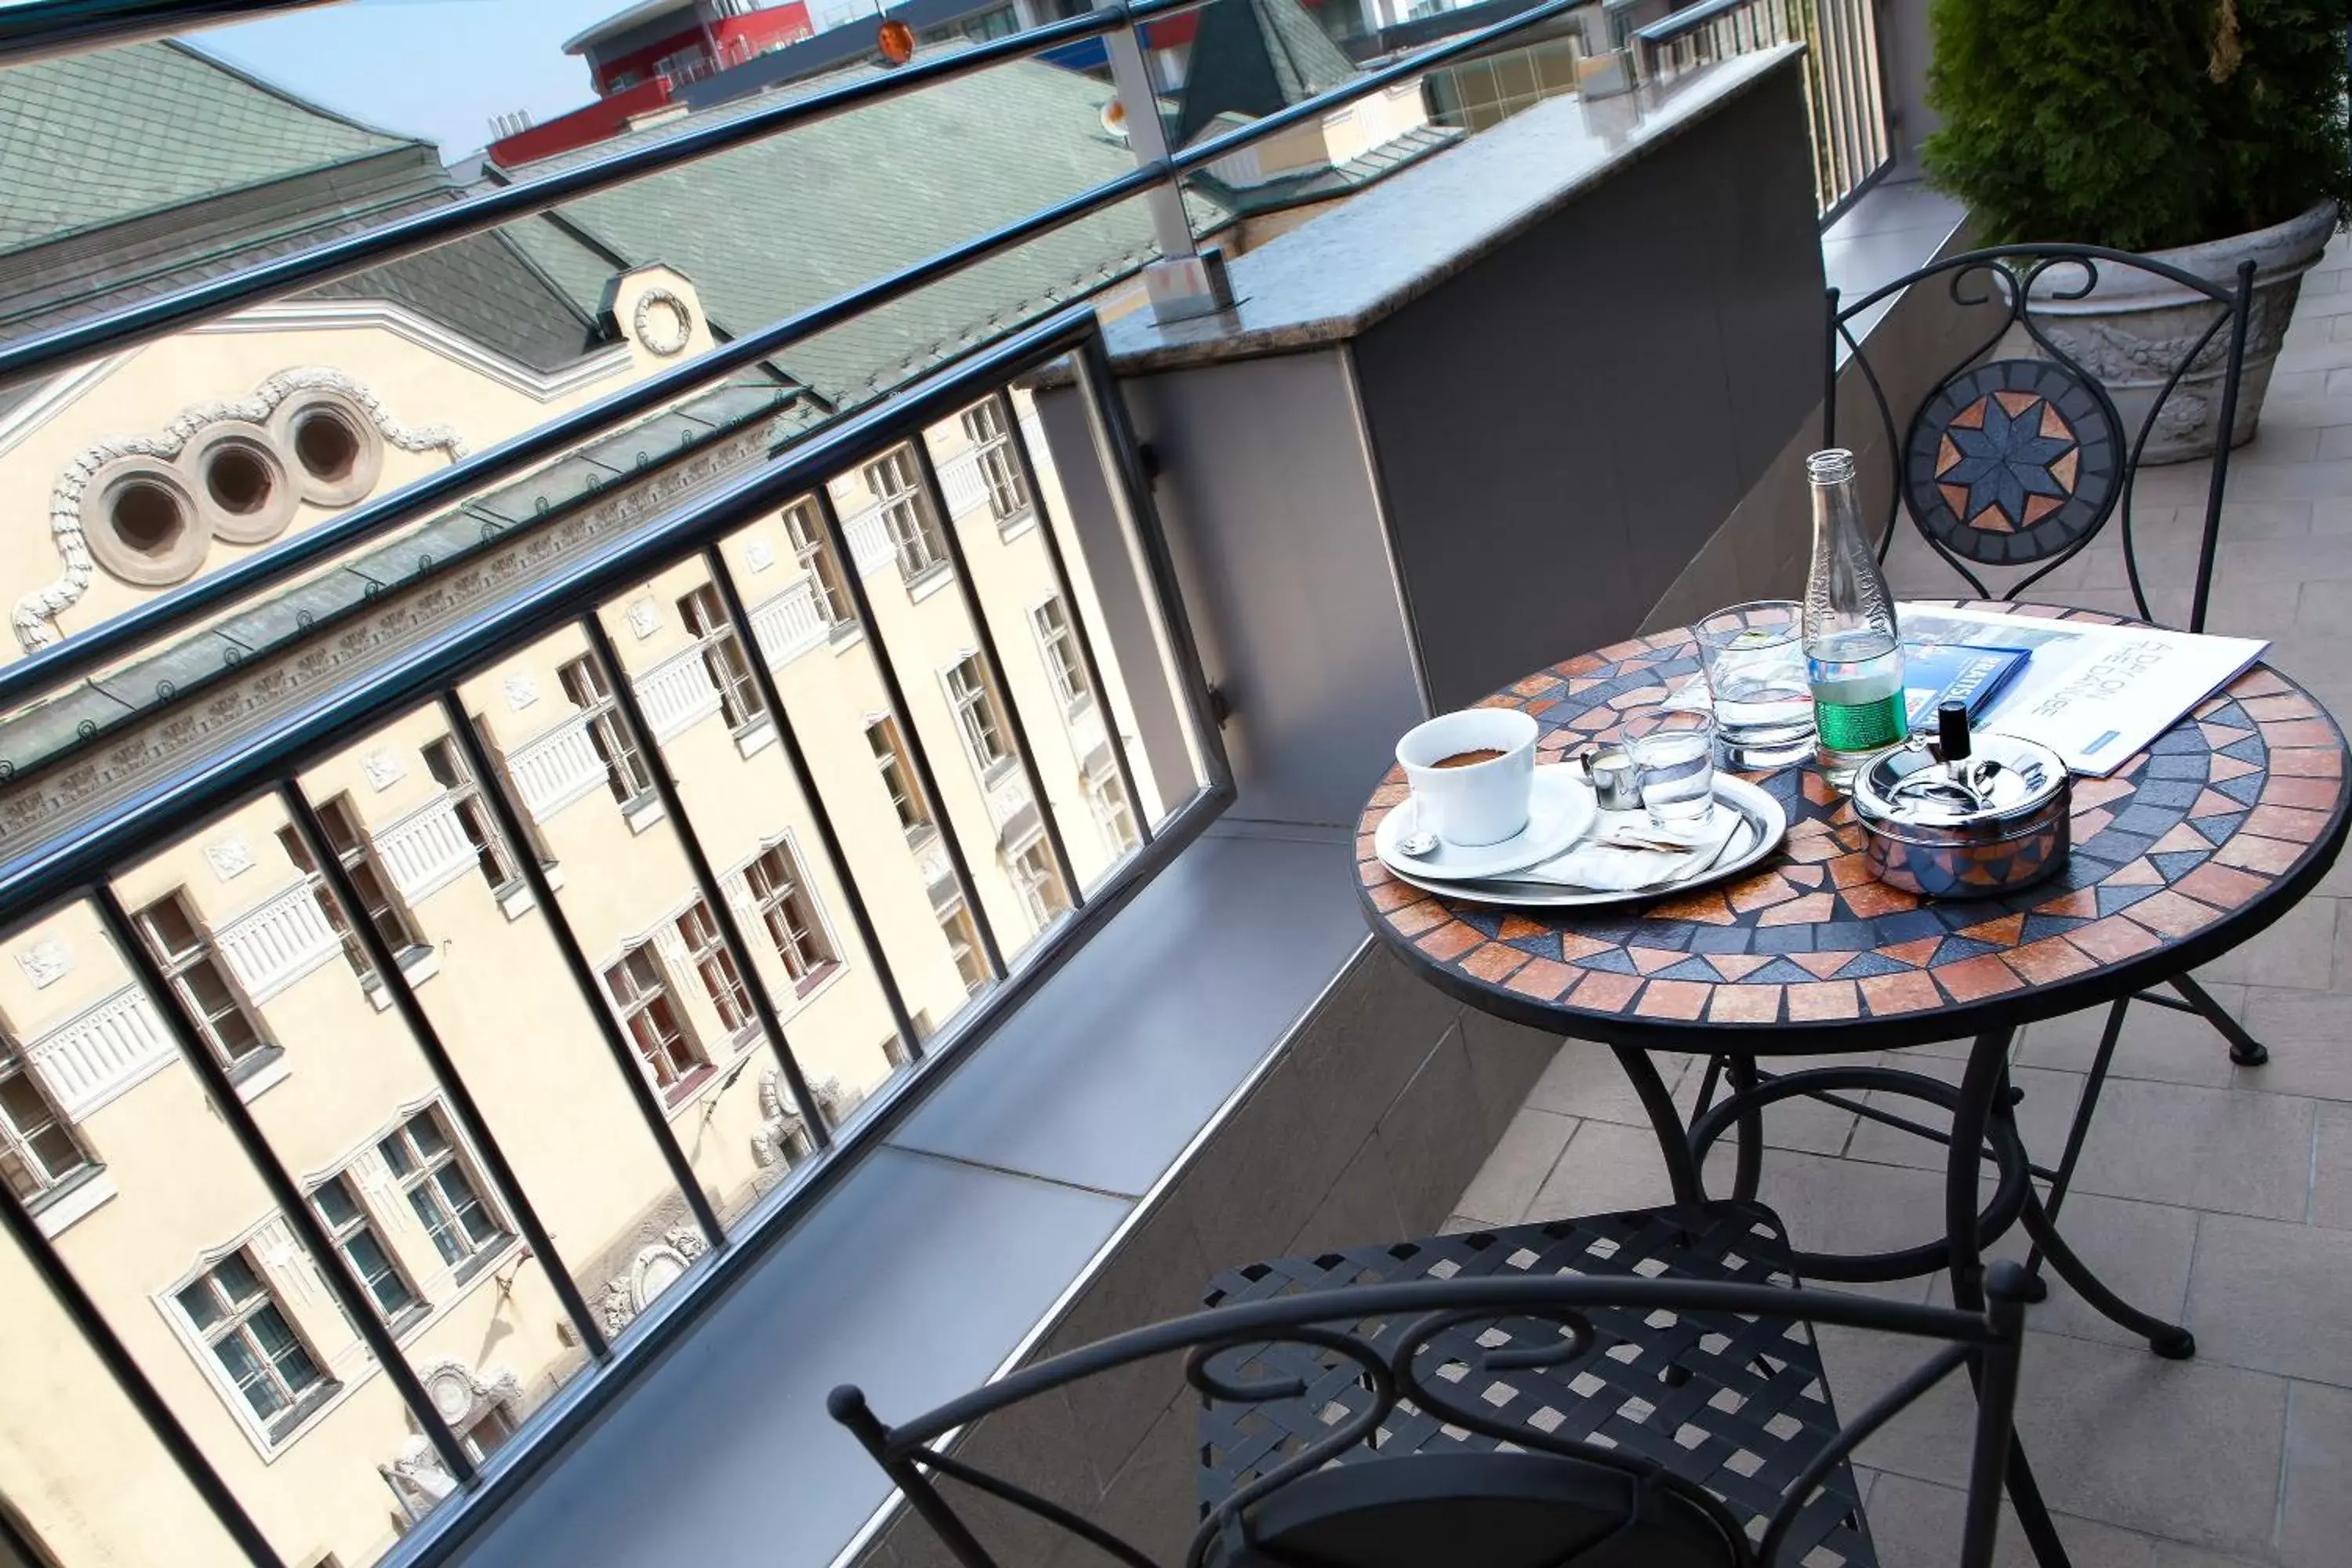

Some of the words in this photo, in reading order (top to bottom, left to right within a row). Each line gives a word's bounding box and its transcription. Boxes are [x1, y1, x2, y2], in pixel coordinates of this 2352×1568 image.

[2102, 641, 2150, 664] THE
[2119, 653, 2161, 677] DAY
[2031, 666, 2115, 717] DANUBE
[2085, 681, 2125, 700] ON
